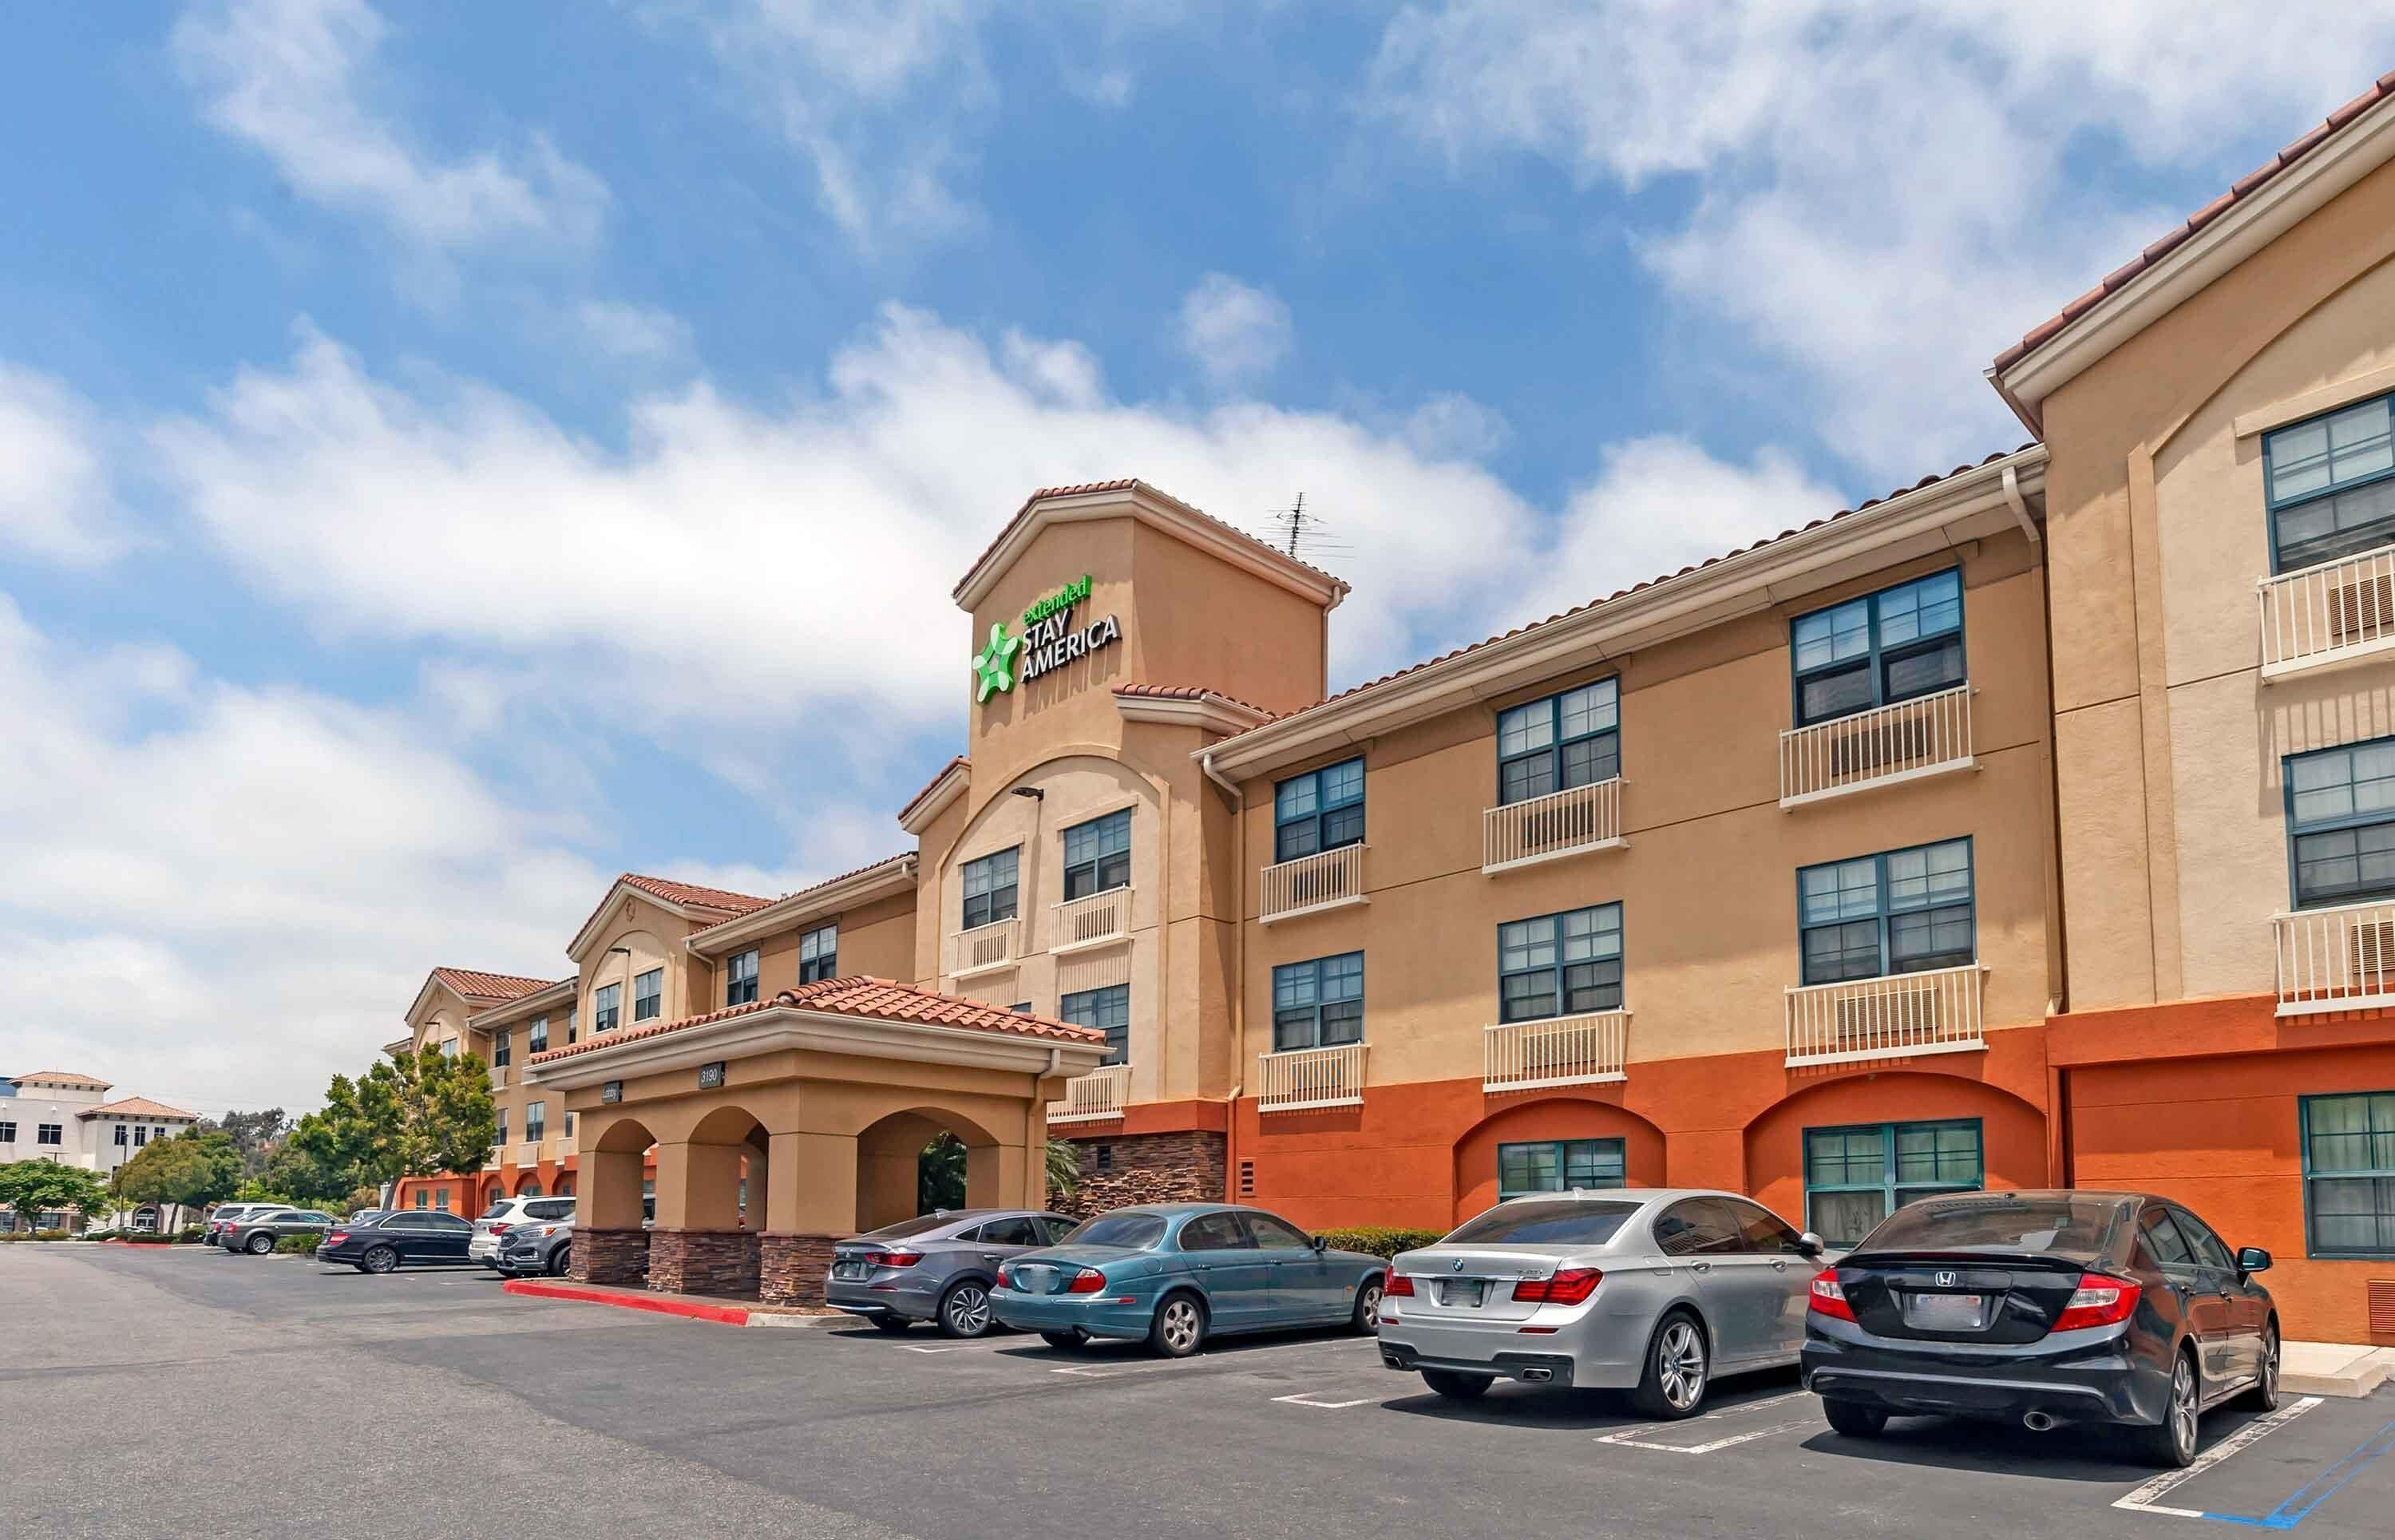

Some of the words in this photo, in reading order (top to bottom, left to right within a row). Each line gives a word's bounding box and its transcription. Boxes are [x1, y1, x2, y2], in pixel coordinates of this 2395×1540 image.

[1022, 575, 1092, 625] extended
[1020, 613, 1122, 683] AMERICA
[1022, 608, 1072, 655] STAY
[701, 1068, 718, 1083] 3190
